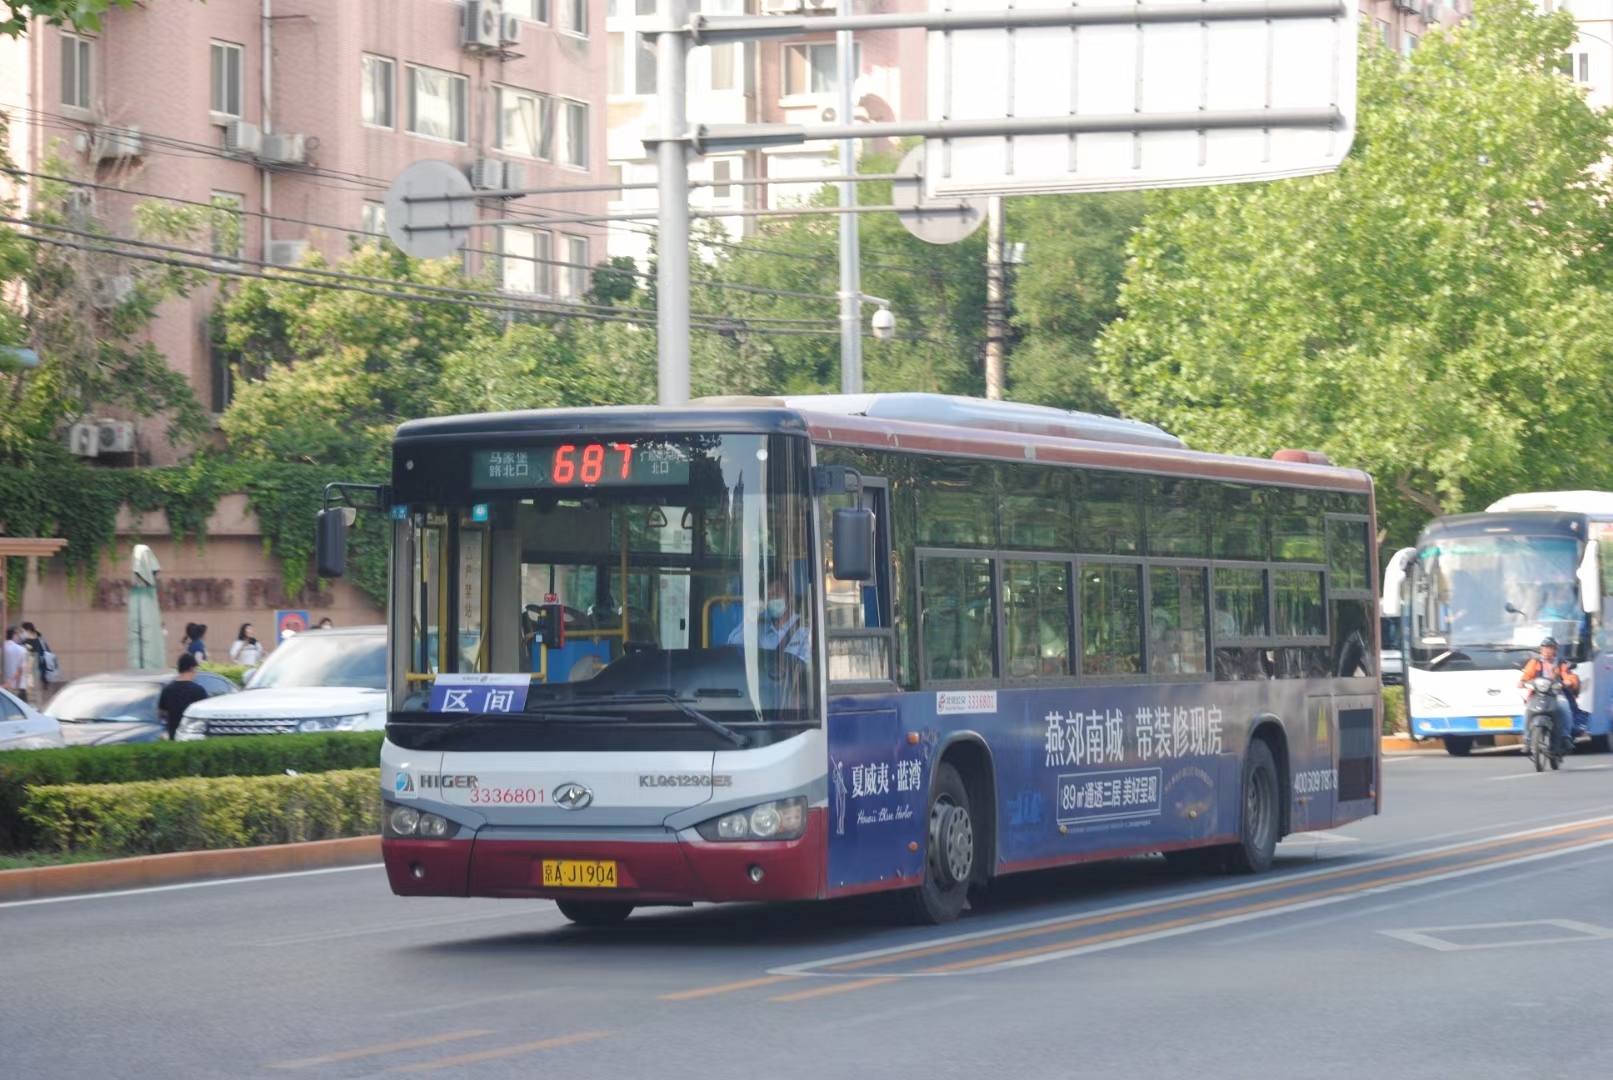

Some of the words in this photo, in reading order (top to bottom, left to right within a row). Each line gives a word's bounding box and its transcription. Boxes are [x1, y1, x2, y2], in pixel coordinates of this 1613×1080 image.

[489, 452, 528, 464] 马家堡
[552, 444, 633, 484] 687
[489, 464, 528, 477] 路北口
[652, 461, 669, 474] 北口
[441, 688, 514, 713] 区间
[968, 695, 993, 709] 3336801
[1045, 708, 1124, 767] 燕郊南城
[1135, 704, 1223, 761] 带装修现房
[420, 774, 478, 788] HIGER
[470, 788, 545, 804] 3336801
[1123, 776, 1157, 805] 美好呈现
[878, 807, 894, 822] Blue
